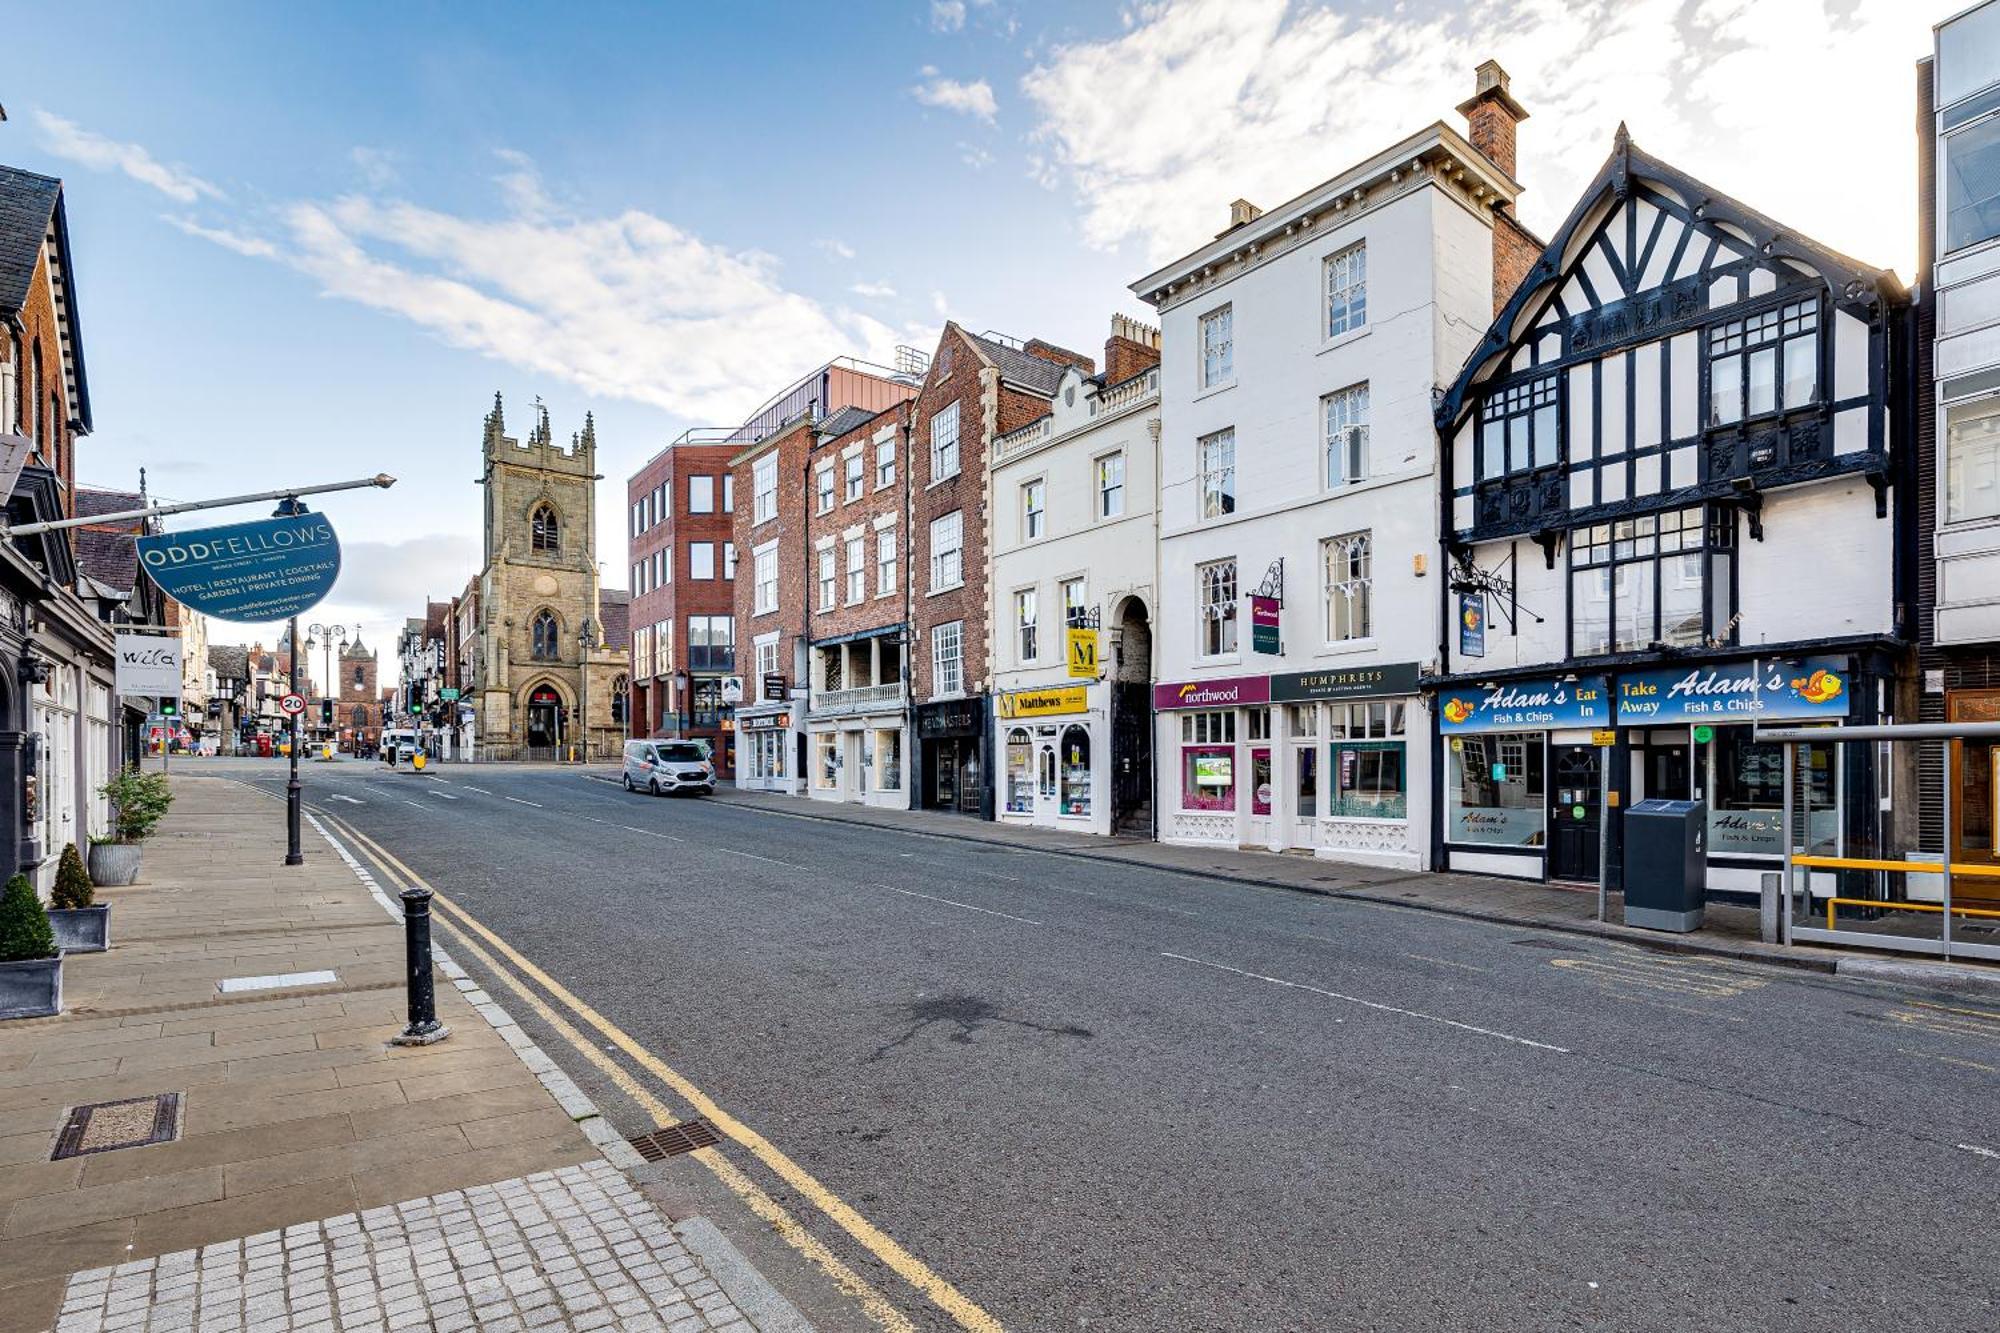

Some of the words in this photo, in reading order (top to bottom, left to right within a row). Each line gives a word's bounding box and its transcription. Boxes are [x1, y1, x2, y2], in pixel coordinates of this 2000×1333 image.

[145, 524, 331, 566] ODDFELLOWS
[172, 584, 209, 595] HOTEL
[213, 571, 276, 588] RESTAURANT
[282, 561, 335, 577] COCKTAILS
[198, 587, 240, 601] GARDEN
[248, 580, 288, 592] PRIVATE
[288, 573, 321, 585] DINING
[1071, 640, 1095, 665] M
[1300, 671, 1383, 687] HUMPHREYS
[1666, 664, 1785, 699] Adam's
[1185, 686, 1238, 703] northwood
[1480, 681, 1568, 712] Adam's
[1575, 688, 1598, 701] Eat
[1621, 681, 1657, 697] Take
[284, 699, 301, 710] 20
[1019, 696, 1061, 710] Matthews
[1580, 705, 1594, 717] In
[1620, 700, 1660, 717] Away
[1684, 701, 1709, 713] Fish
[1713, 700, 1723, 711] &
[1727, 698, 1764, 713] Chips
[1494, 713, 1513, 723] Fish
[1516, 713, 1523, 722] &
[1526, 711, 1554, 723] Chips
[1460, 811, 1508, 824] Adam's
